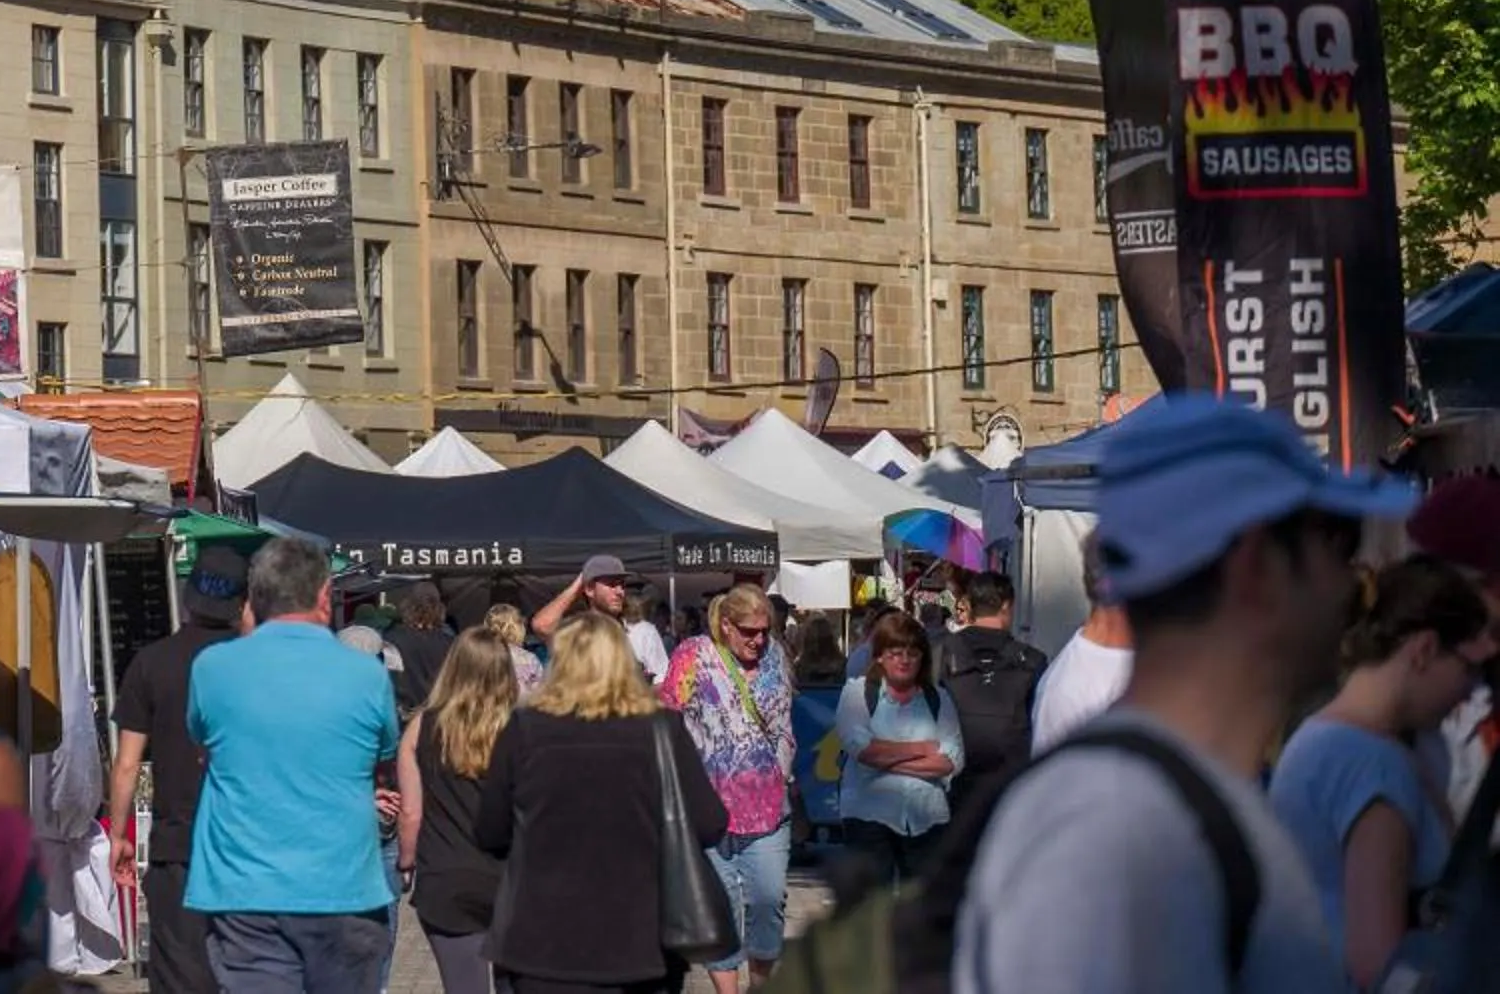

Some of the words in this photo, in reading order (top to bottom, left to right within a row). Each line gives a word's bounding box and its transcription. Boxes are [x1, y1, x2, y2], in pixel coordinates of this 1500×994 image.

[1177, 4, 1359, 80] BBQ
[1202, 146, 1353, 176] SAUSAGES
[233, 181, 277, 196] Jasper
[281, 178, 328, 191] Coffee
[295, 266, 338, 279] Neutral
[382, 542, 523, 565] Tasmania
[677, 544, 703, 565] Made
[726, 542, 775, 565] Tasmania
